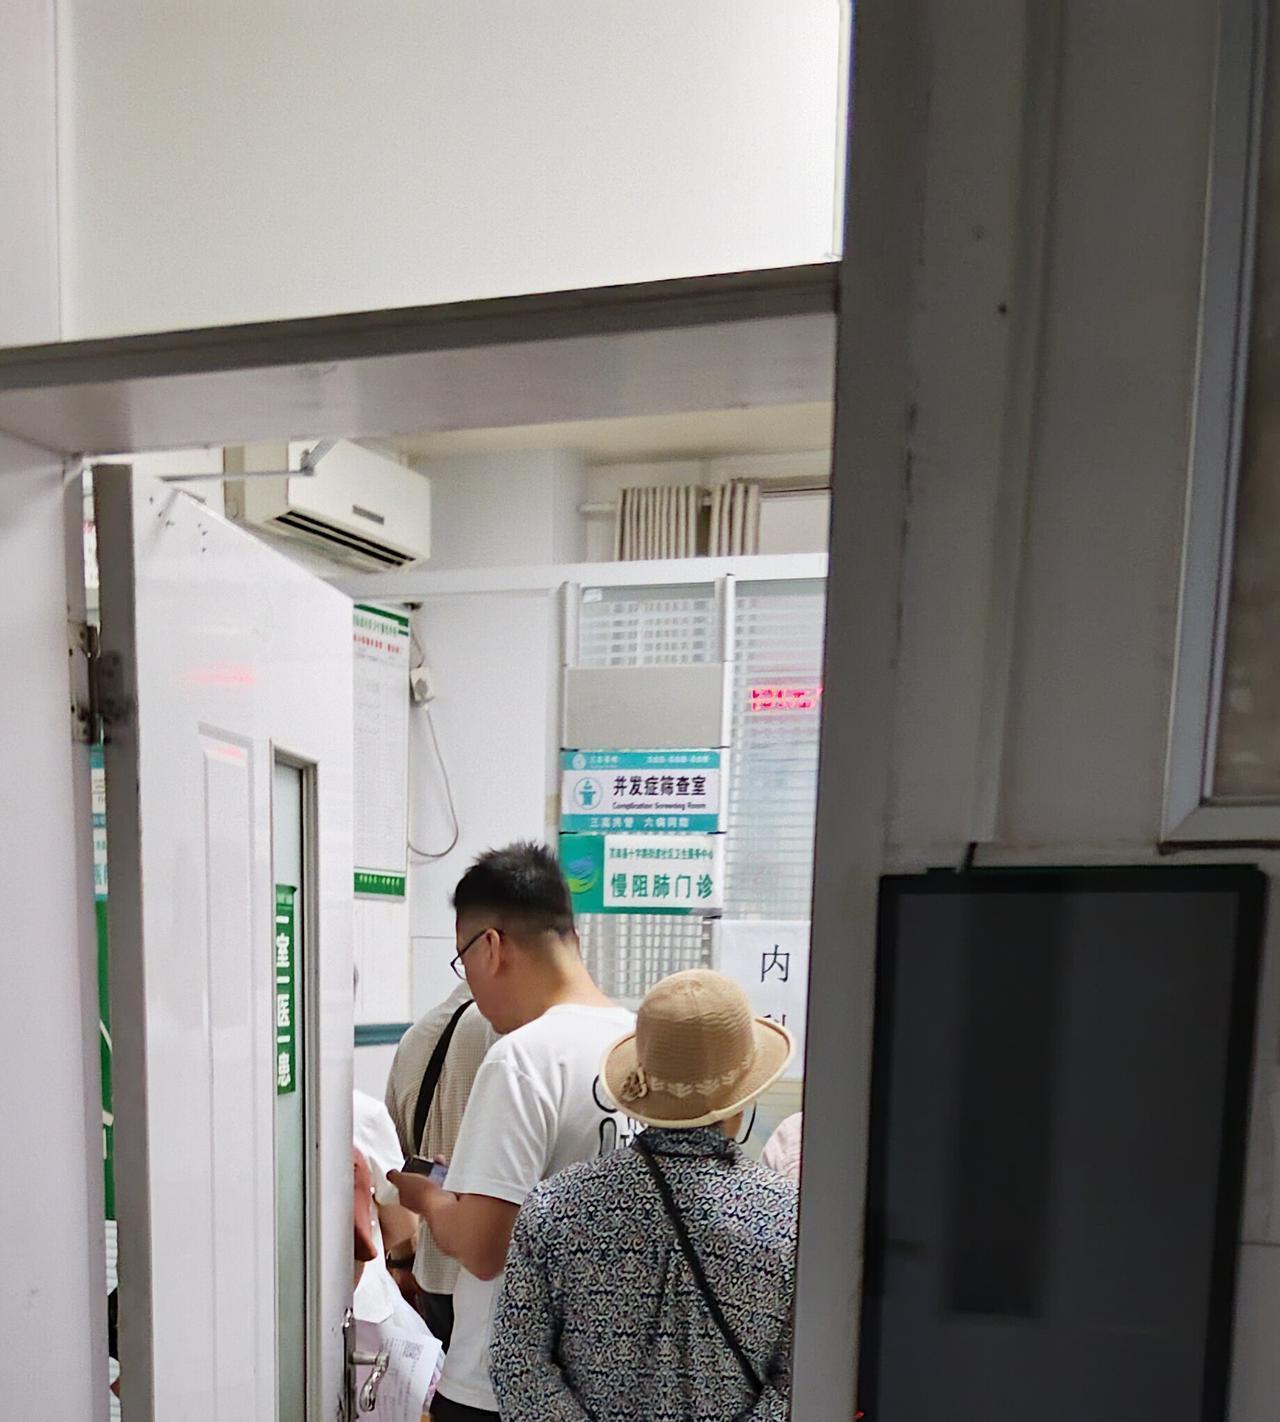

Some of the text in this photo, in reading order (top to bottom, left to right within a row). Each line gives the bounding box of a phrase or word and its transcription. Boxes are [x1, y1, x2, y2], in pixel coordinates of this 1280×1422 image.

[613, 776, 706, 797] 并发症筛查室
[687, 801, 706, 809] Room
[611, 873, 713, 899] 慢阻肺门诊
